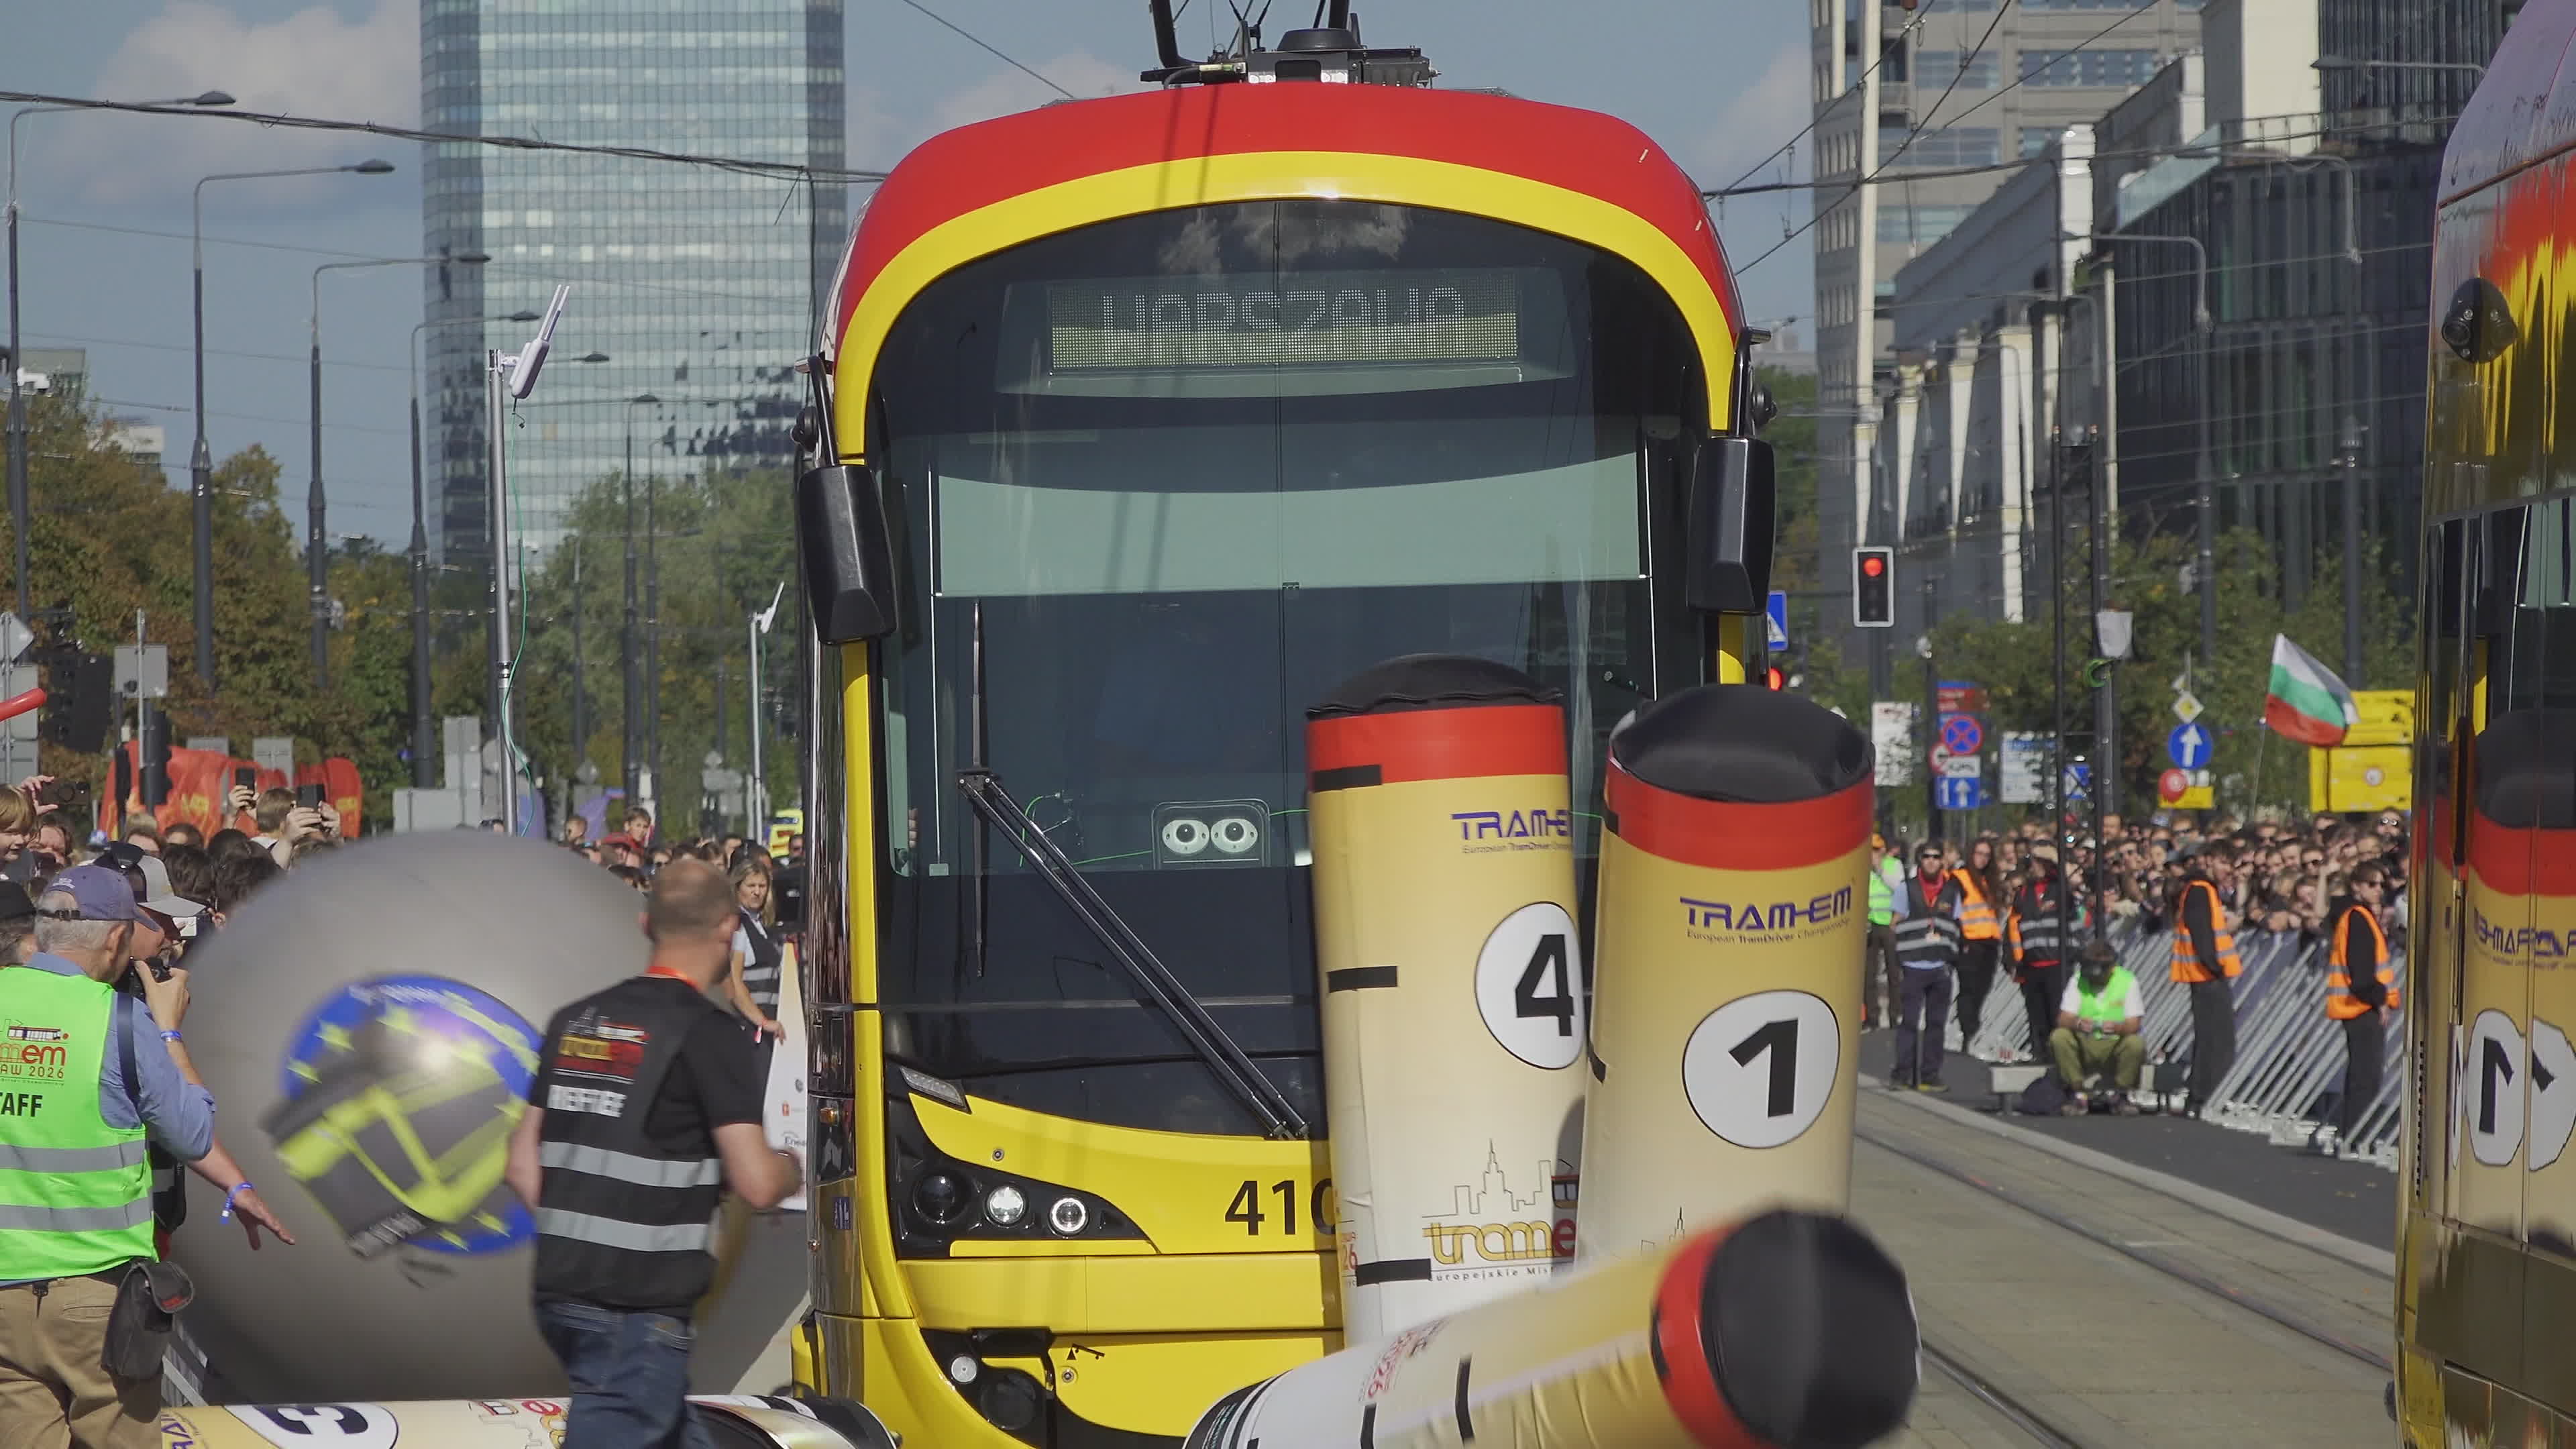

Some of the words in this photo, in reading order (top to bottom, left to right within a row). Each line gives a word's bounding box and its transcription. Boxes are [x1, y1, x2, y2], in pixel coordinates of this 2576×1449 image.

[1102, 286, 1466, 362] WARSZAWA
[1515, 933, 1574, 1036] 4
[29, 1065, 64, 1079] 2026
[1729, 1019, 1799, 1118] 1
[0, 1091, 43, 1118] AFF
[1429, 1269, 1519, 1283] uropejskie
